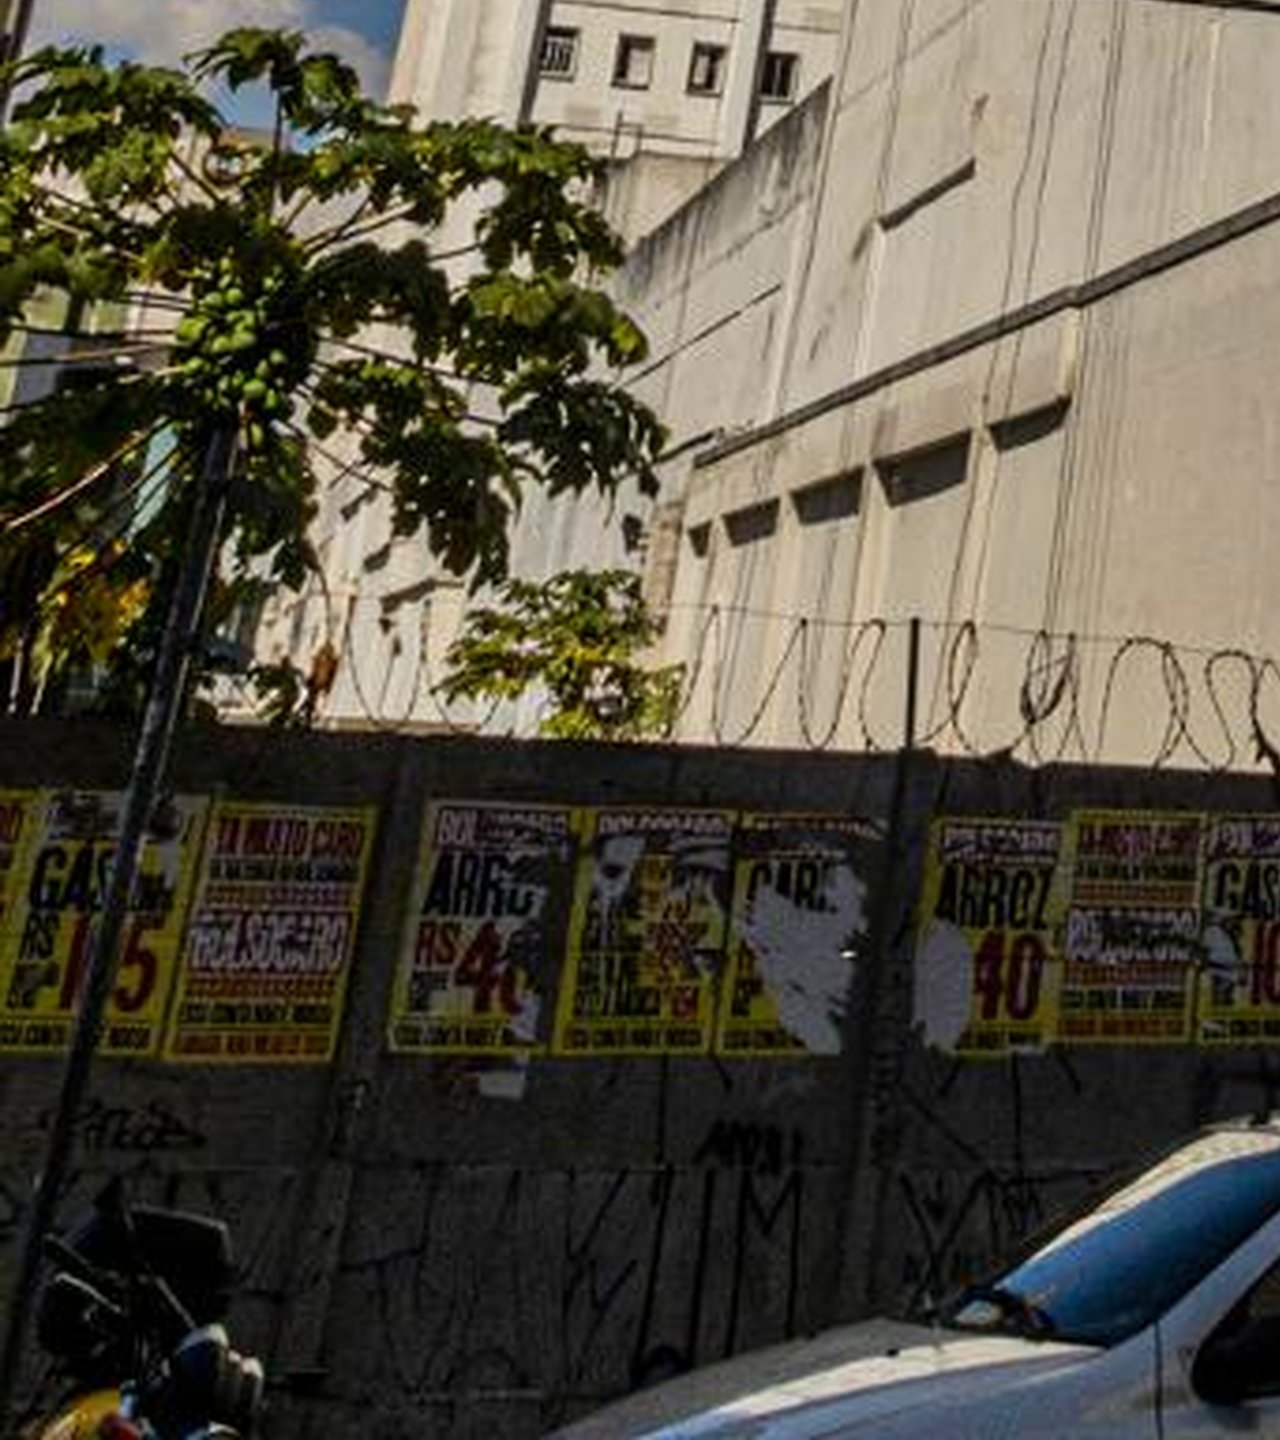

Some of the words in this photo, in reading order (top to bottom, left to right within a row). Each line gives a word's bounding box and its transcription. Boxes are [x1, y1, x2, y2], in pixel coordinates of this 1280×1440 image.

[421, 849, 540, 918] ARRO
[934, 864, 1055, 930] ARROZ
[60, 913, 166, 1012] 15
